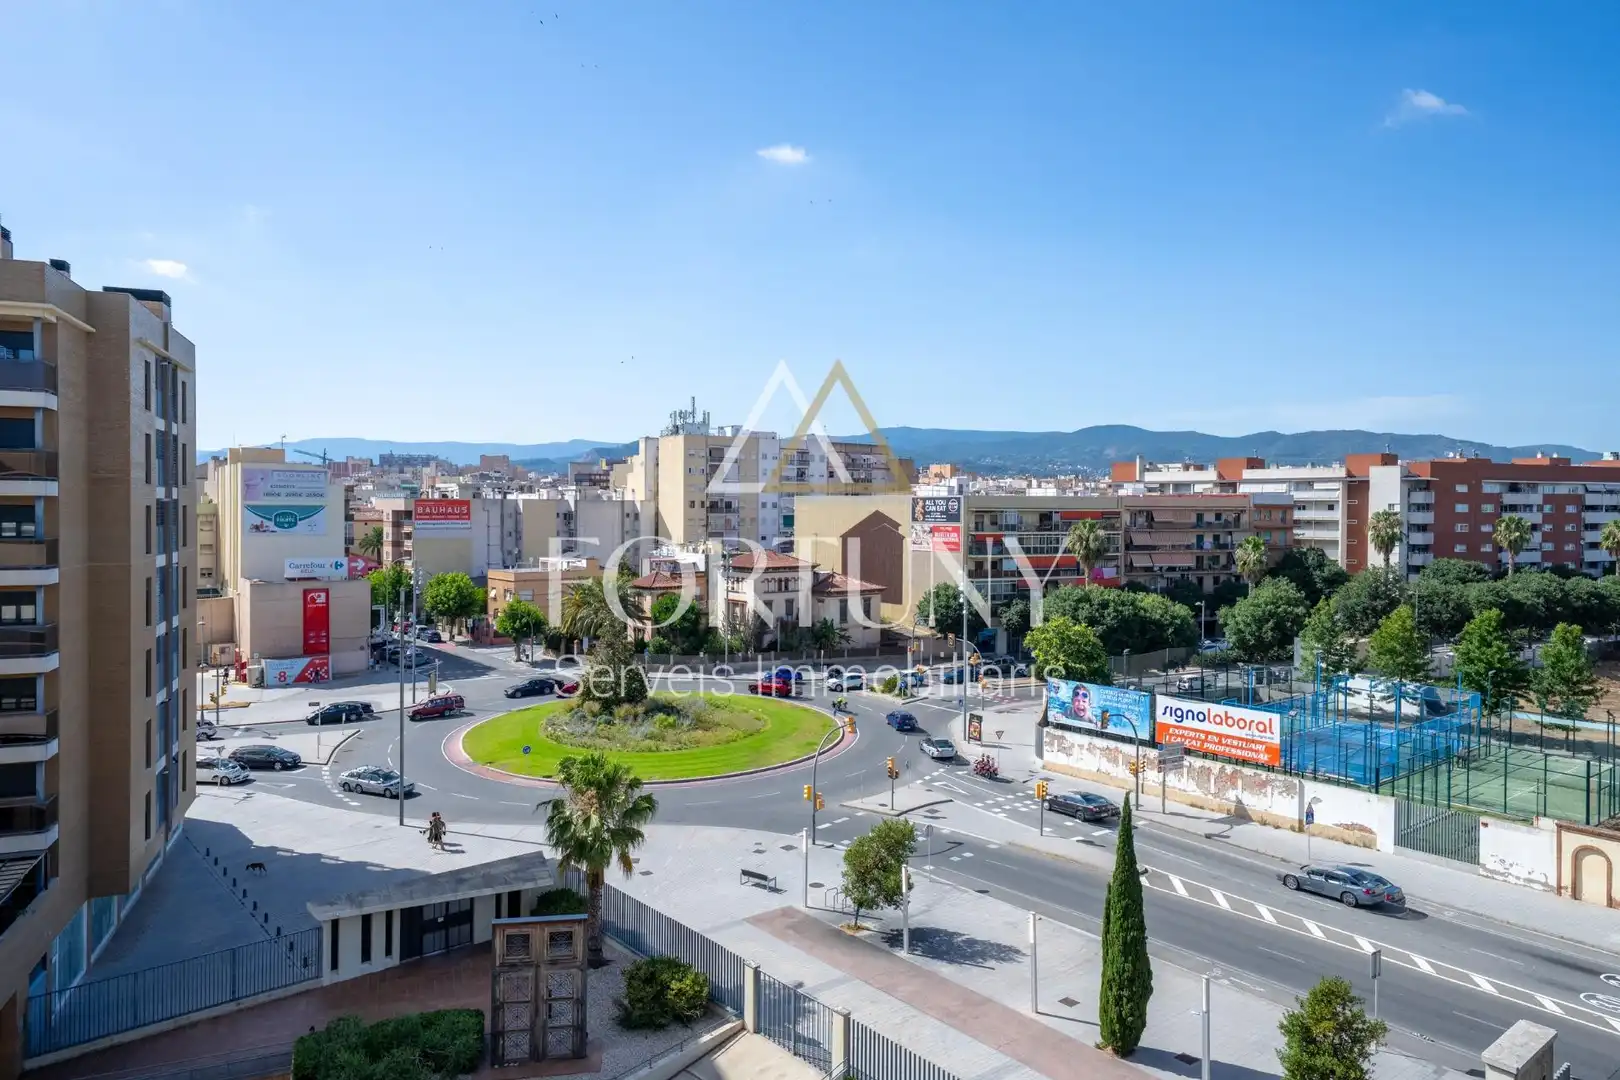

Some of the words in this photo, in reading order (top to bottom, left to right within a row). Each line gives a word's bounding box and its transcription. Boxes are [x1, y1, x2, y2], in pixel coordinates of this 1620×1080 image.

[417, 506, 468, 514] BAUHAUS
[288, 561, 326, 569] Carrefour
[1162, 705, 1275, 735] signolaboral
[1169, 727, 1206, 740] EXPERTS
[1208, 734, 1220, 743] EN
[1222, 738, 1266, 751] VESTUARI
[1203, 742, 1271, 761] PROFESSIONAL
